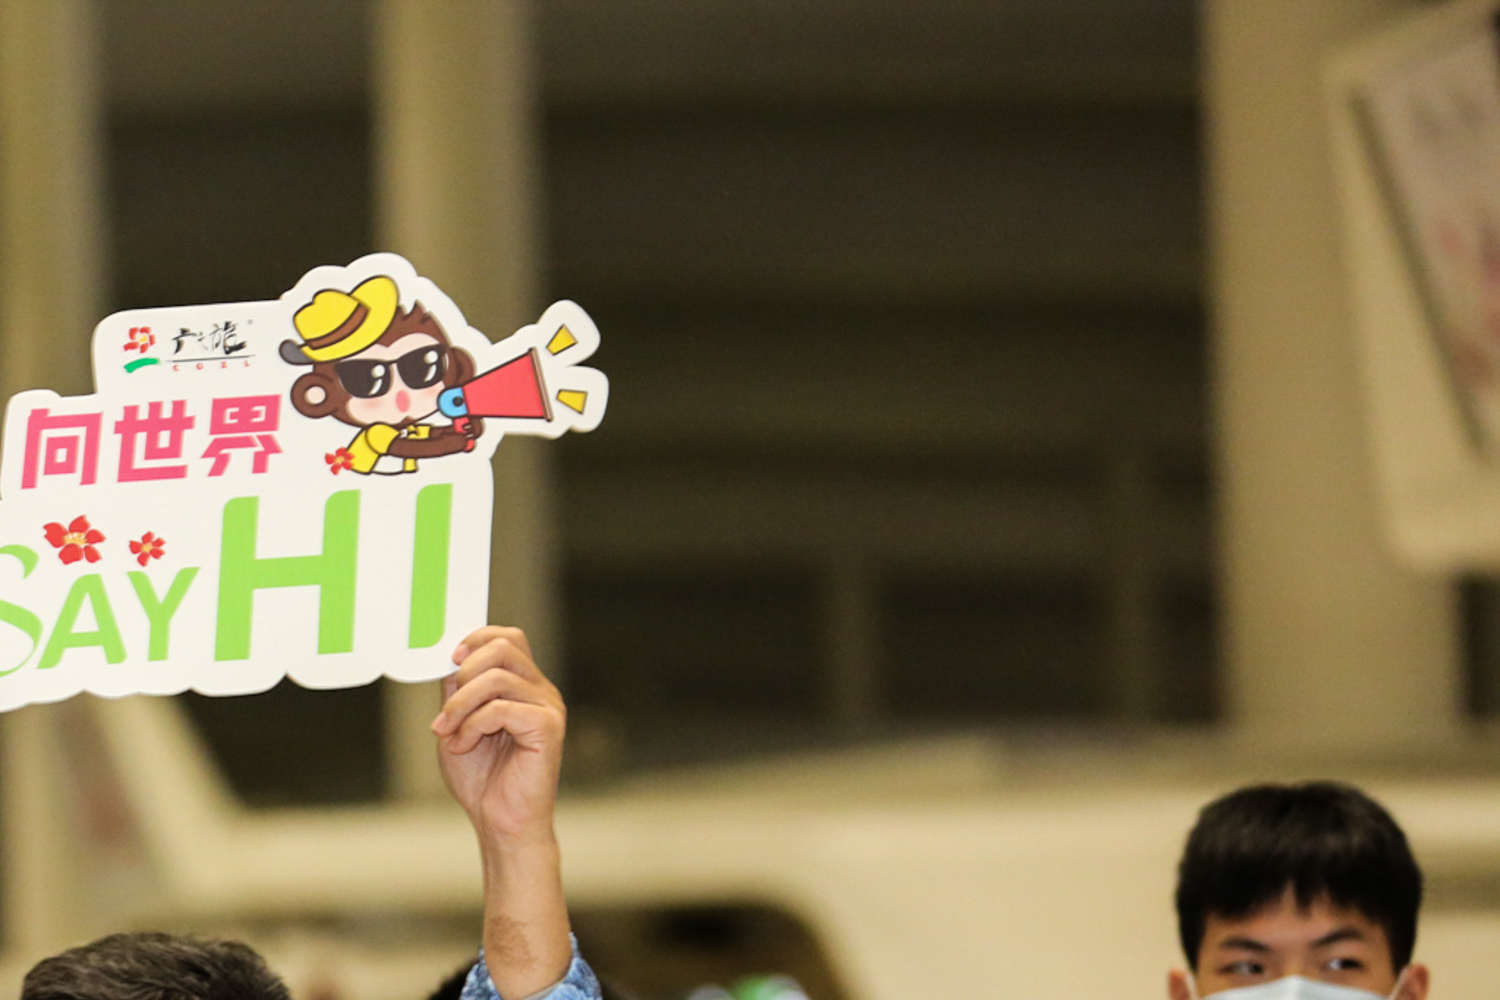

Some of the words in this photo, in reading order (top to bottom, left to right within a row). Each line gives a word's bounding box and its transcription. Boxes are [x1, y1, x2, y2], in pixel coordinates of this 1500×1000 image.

[172, 321, 247, 355] 广之旅
[21, 394, 283, 490] 向世界
[214, 483, 453, 662] HI
